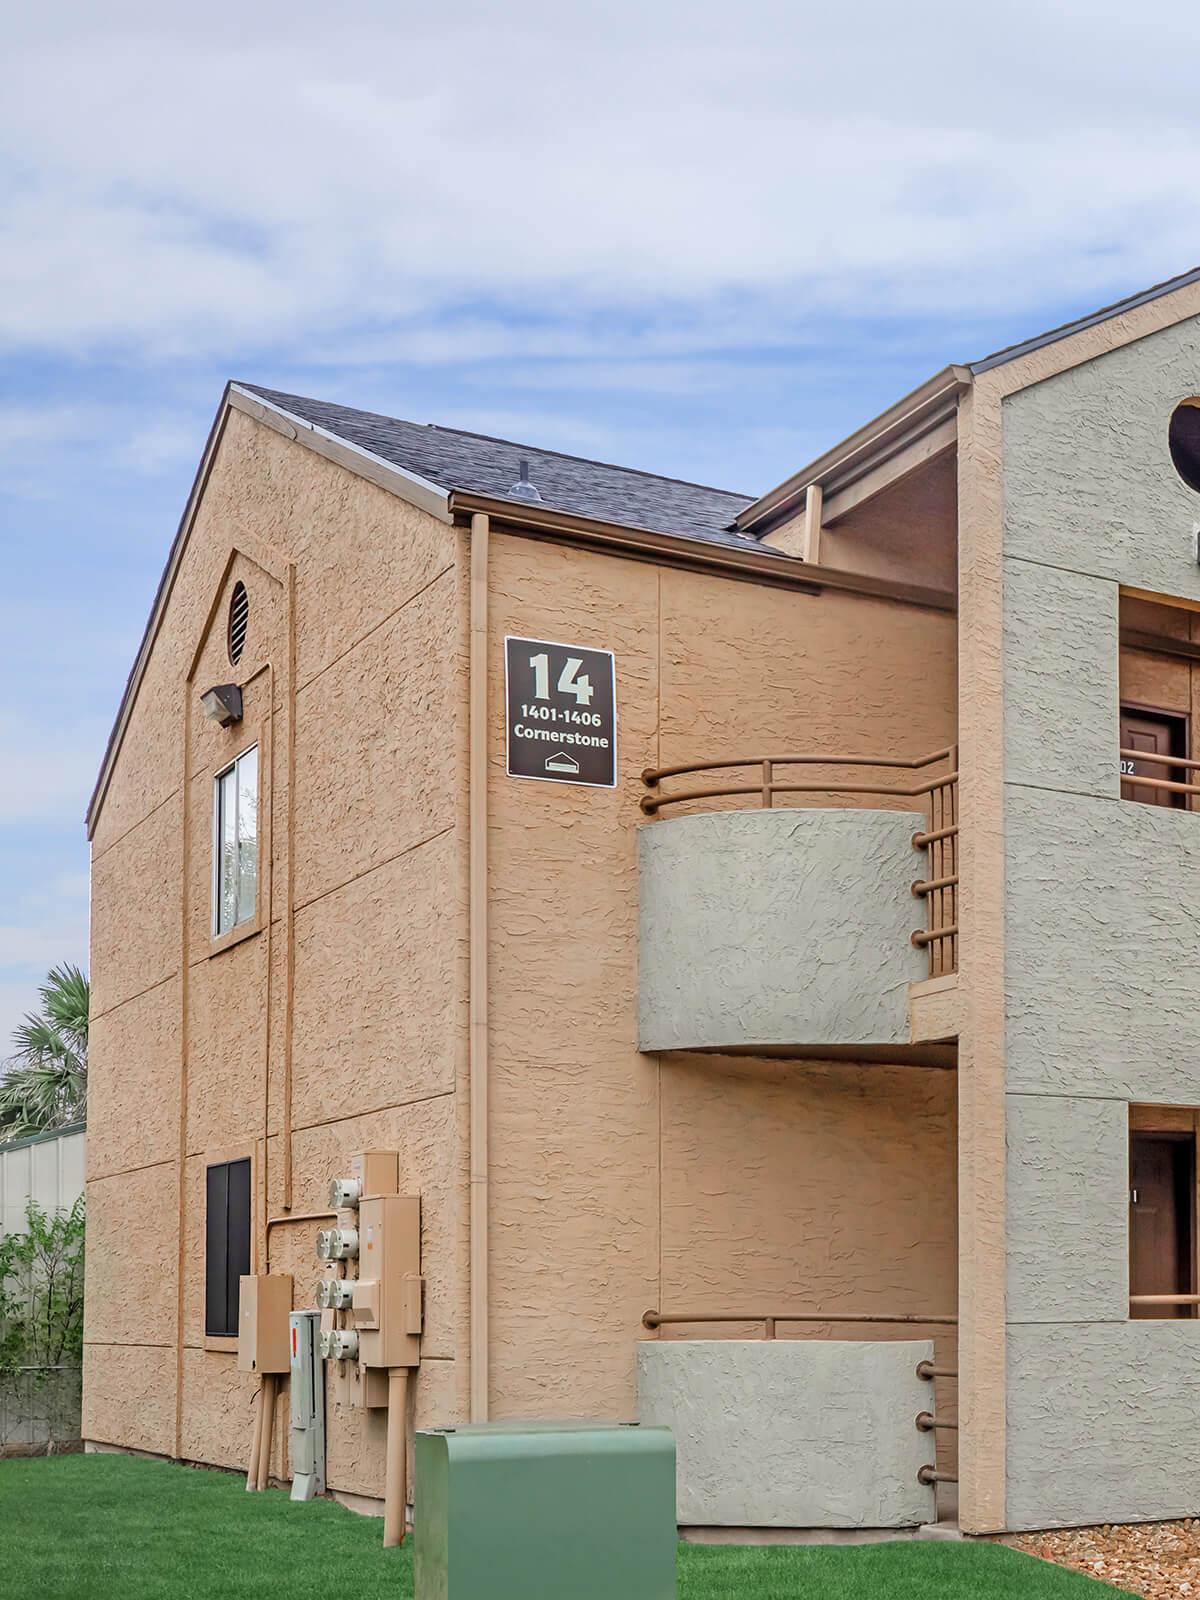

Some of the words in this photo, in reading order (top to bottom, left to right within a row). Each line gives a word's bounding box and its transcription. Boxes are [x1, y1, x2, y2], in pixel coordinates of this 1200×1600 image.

[530, 653, 594, 705] 14
[521, 704, 602, 727] 1401-1406
[514, 724, 609, 748] Cornerstone
